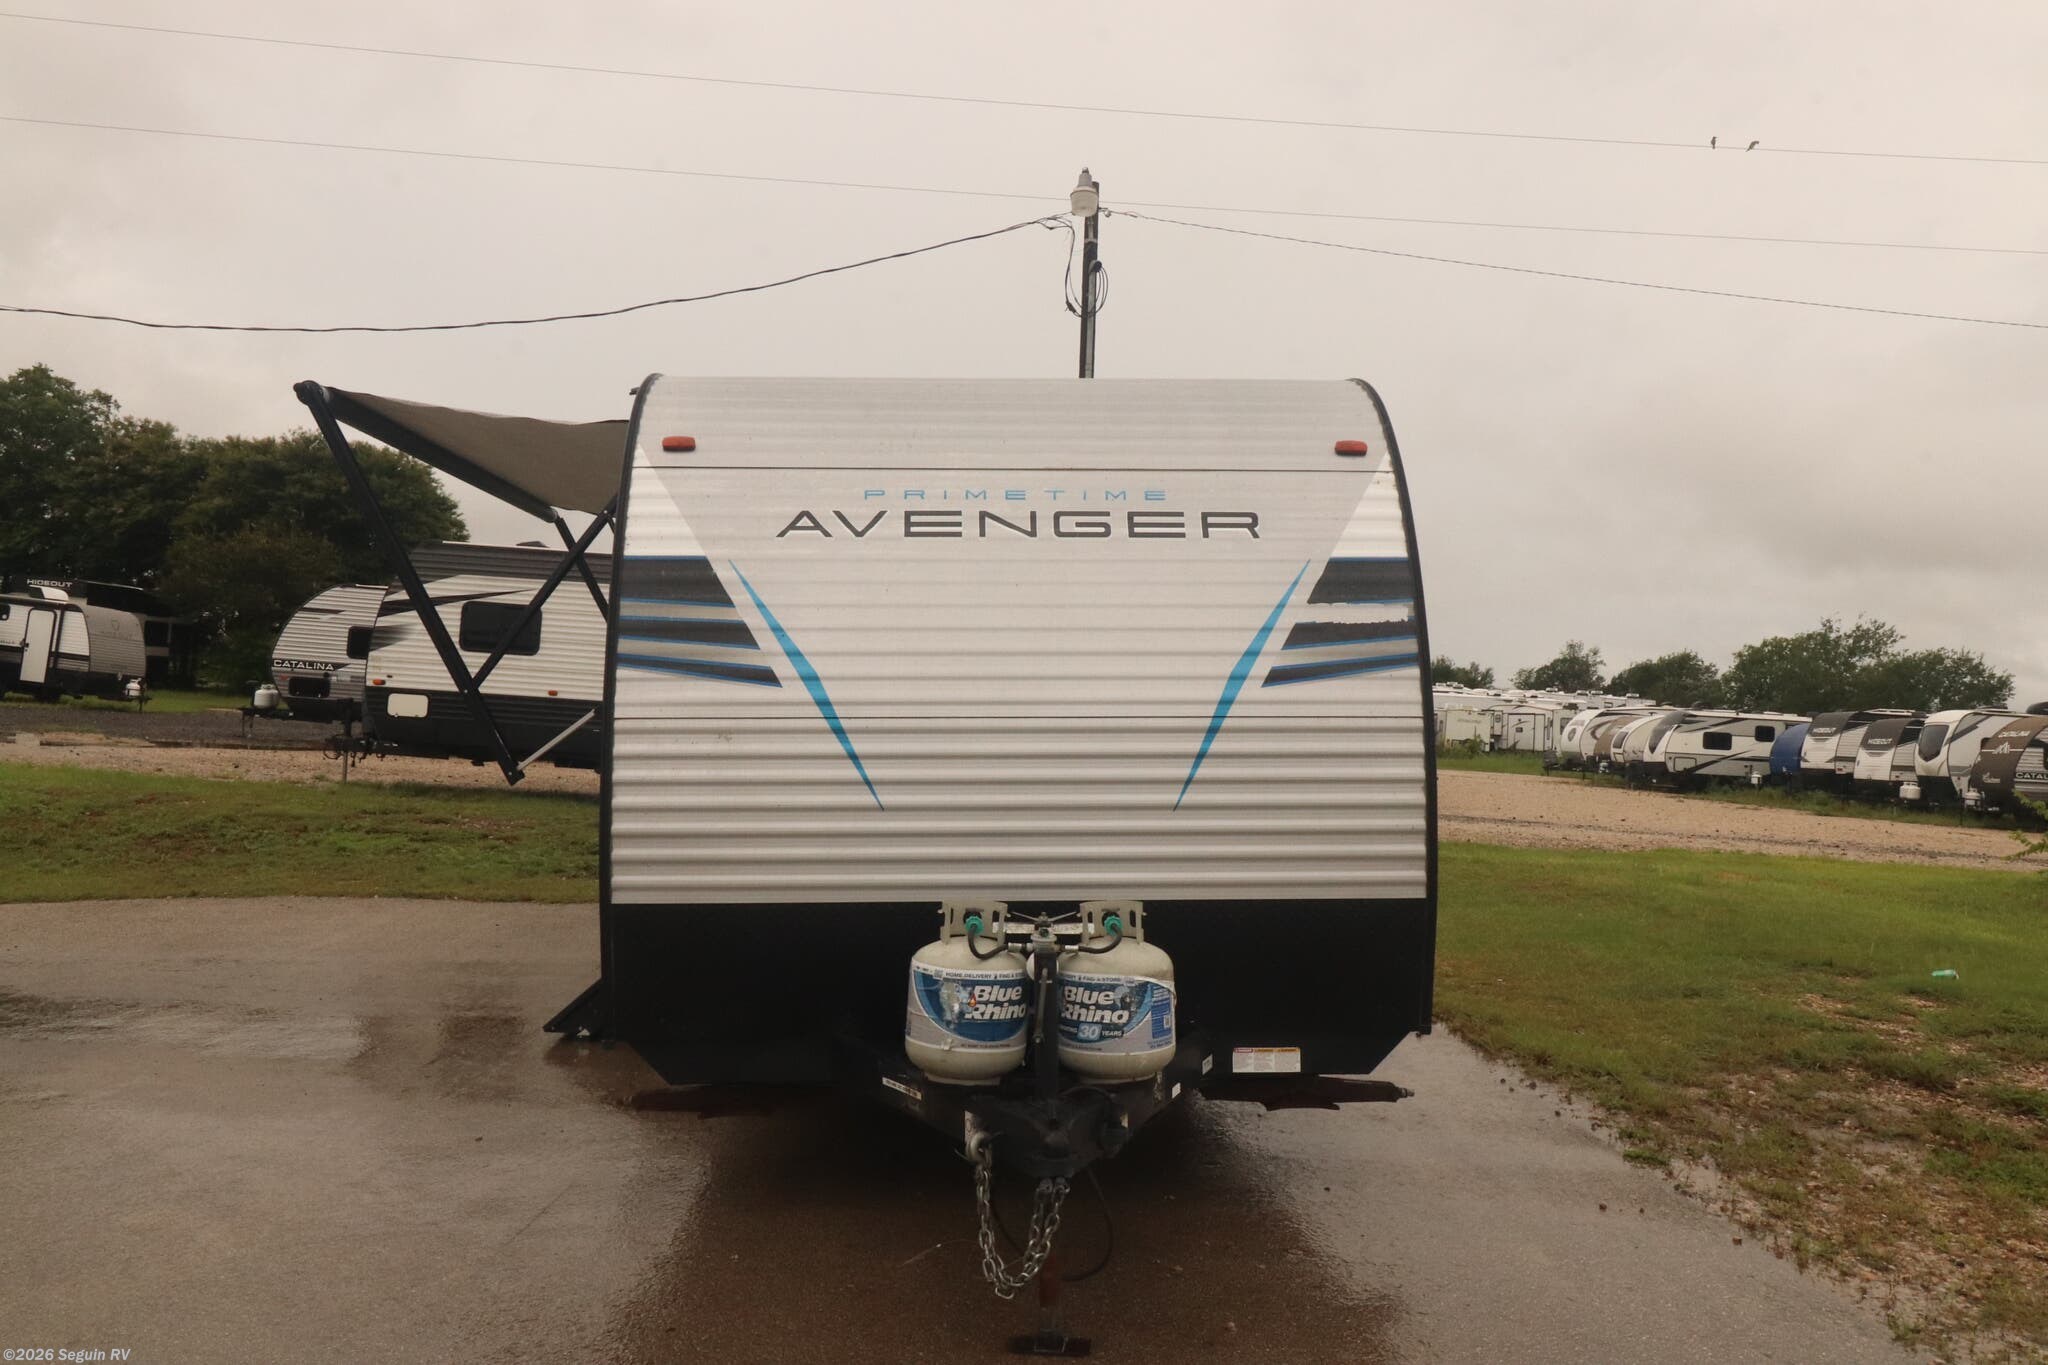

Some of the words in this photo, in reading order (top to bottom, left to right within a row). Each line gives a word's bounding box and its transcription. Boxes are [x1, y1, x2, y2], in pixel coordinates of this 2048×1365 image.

[863, 489, 1166, 501] PRIMETIME
[775, 510, 1260, 539] AVENGER
[26, 578, 73, 588] HIDEOUT
[273, 659, 335, 671] CATALINA
[974, 985, 1023, 1002] Blue
[1063, 986, 1114, 1005] Blue
[964, 1003, 1026, 1020] Rhino
[1061, 1004, 1130, 1024] Rhino
[1079, 1024, 1099, 1038] 30
